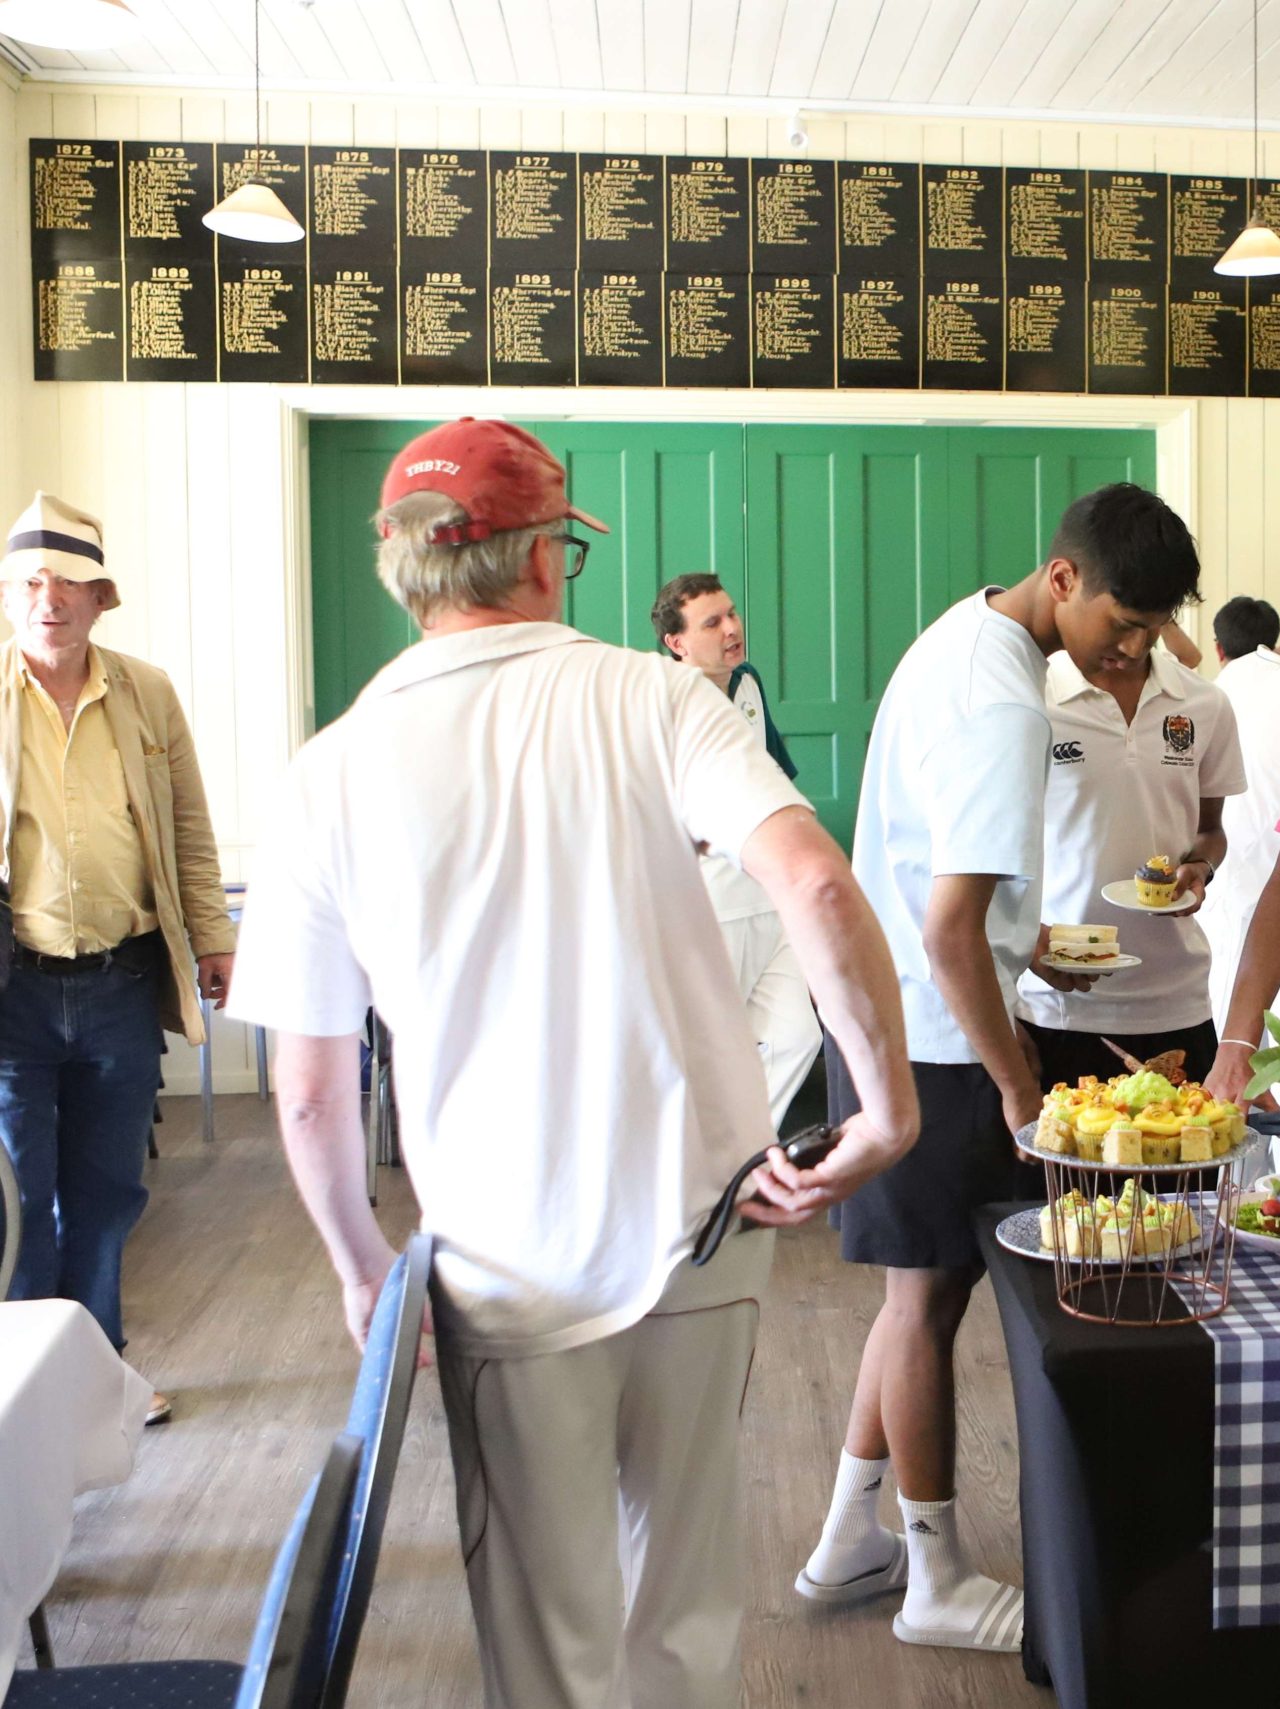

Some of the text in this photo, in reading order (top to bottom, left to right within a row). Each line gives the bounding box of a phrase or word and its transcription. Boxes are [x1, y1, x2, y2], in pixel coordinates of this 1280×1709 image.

[56, 144, 93, 155] 1872
[149, 147, 185, 158] 1873
[243, 149, 277, 160] 1874
[335, 152, 369, 162] 1875
[423, 154, 458, 164] 1876
[515, 156, 550, 166] 1877
[605, 159, 640, 169] 1878
[691, 161, 724, 172] 1879
[779, 163, 813, 173] 1880
[862, 166, 893, 176] 1881
[947, 170, 979, 180] 1882
[1030, 172, 1062, 183] 1883
[1111, 176, 1143, 186] 1884
[1190, 179, 1223, 189] 1885
[58, 266, 95, 276] 1888
[151, 267, 189, 278] 1889
[243, 269, 282, 280] 1890
[336, 271, 369, 281] 1891
[426, 272, 462, 283] 1892
[515, 274, 551, 284] 1893
[603, 275, 637, 286] 1894
[687, 276, 723, 287] 1895
[775, 278, 810, 288] 1896
[861, 280, 894, 290] 1897
[946, 282, 980, 293] 1898
[1029, 285, 1062, 295] 1899
[1111, 288, 1142, 298] 1900
[1193, 290, 1221, 301] 1901
[405, 459, 462, 478] THBY21
